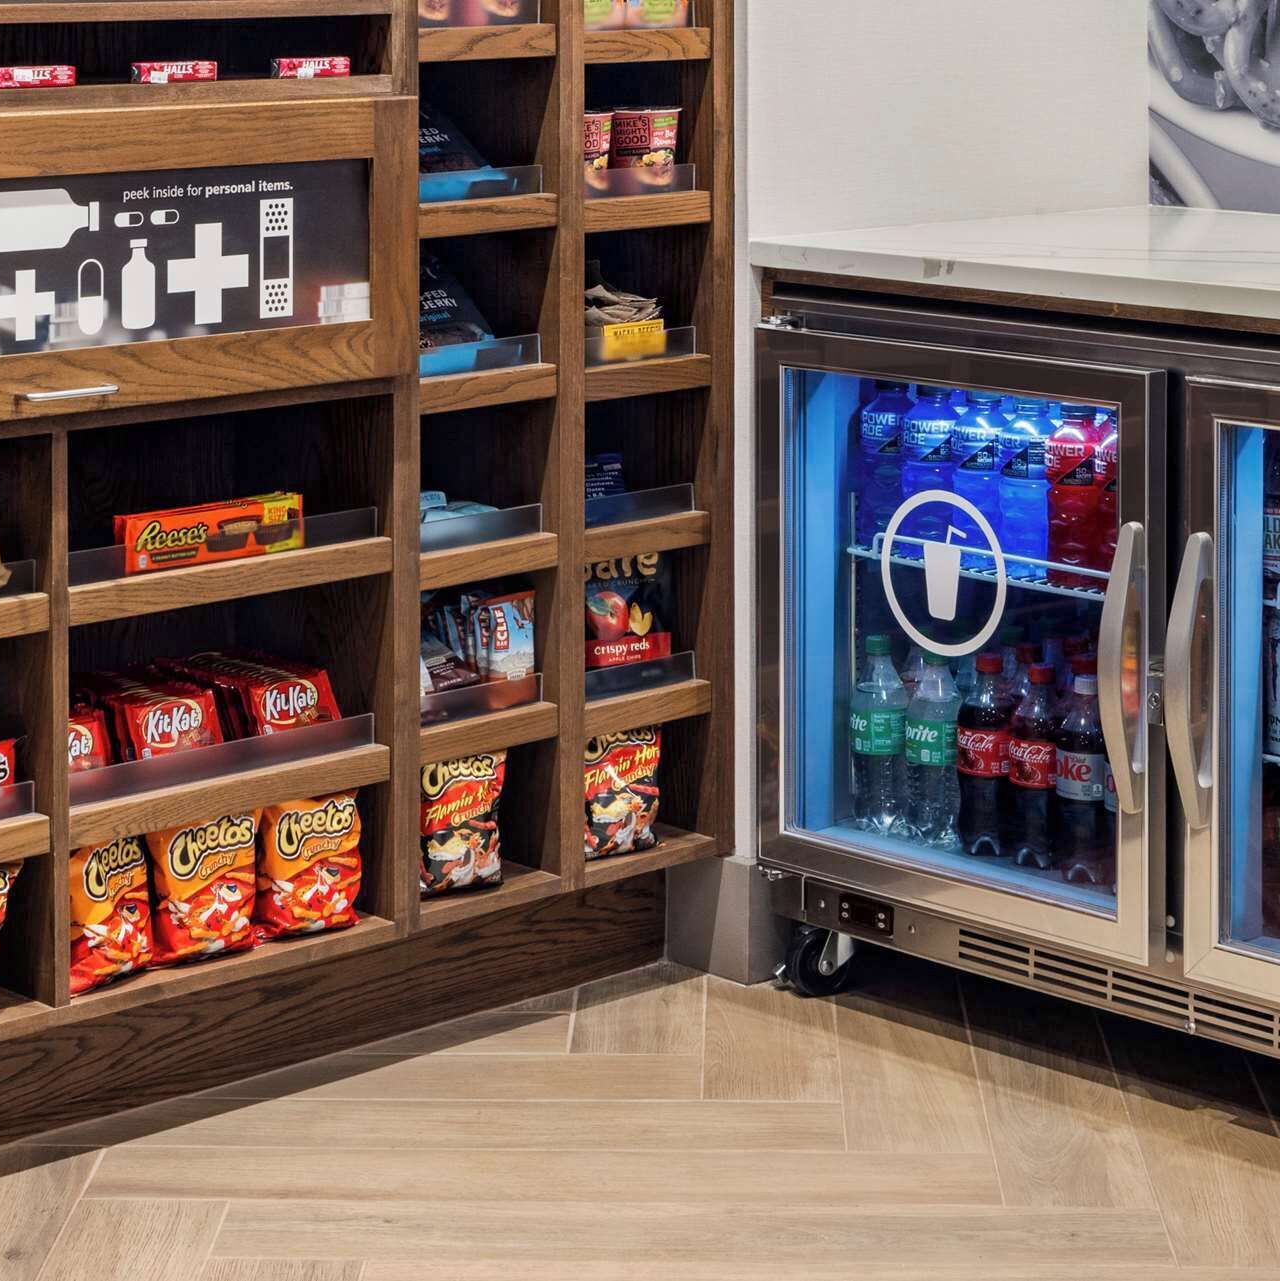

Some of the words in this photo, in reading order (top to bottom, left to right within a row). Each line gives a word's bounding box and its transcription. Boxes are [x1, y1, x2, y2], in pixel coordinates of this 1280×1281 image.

[163, 64, 194, 76] HALLS
[419, 133, 450, 144] ERKY
[122, 185, 151, 202] peek
[153, 184, 184, 200] inside
[186, 183, 204, 197] for
[205, 179, 256, 199] personal
[258, 179, 294, 193] items.
[422, 296, 458, 310] JERKY
[903, 416, 950, 433] POWER
[903, 430, 926, 446] ADE
[134, 521, 209, 552] Reese's
[594, 642, 629, 657] crispy
[629, 638, 651, 652] reds
[266, 685, 318, 722] KitKat
[146, 704, 202, 745] KitKat
[422, 754, 496, 795] Cheetos
[277, 800, 356, 858] Cheetos
[170, 816, 254, 879] Cheetos
[302, 837, 343, 861] Crunchy
[85, 837, 143, 901] Cheetos
[199, 851, 238, 880] Crunchy
